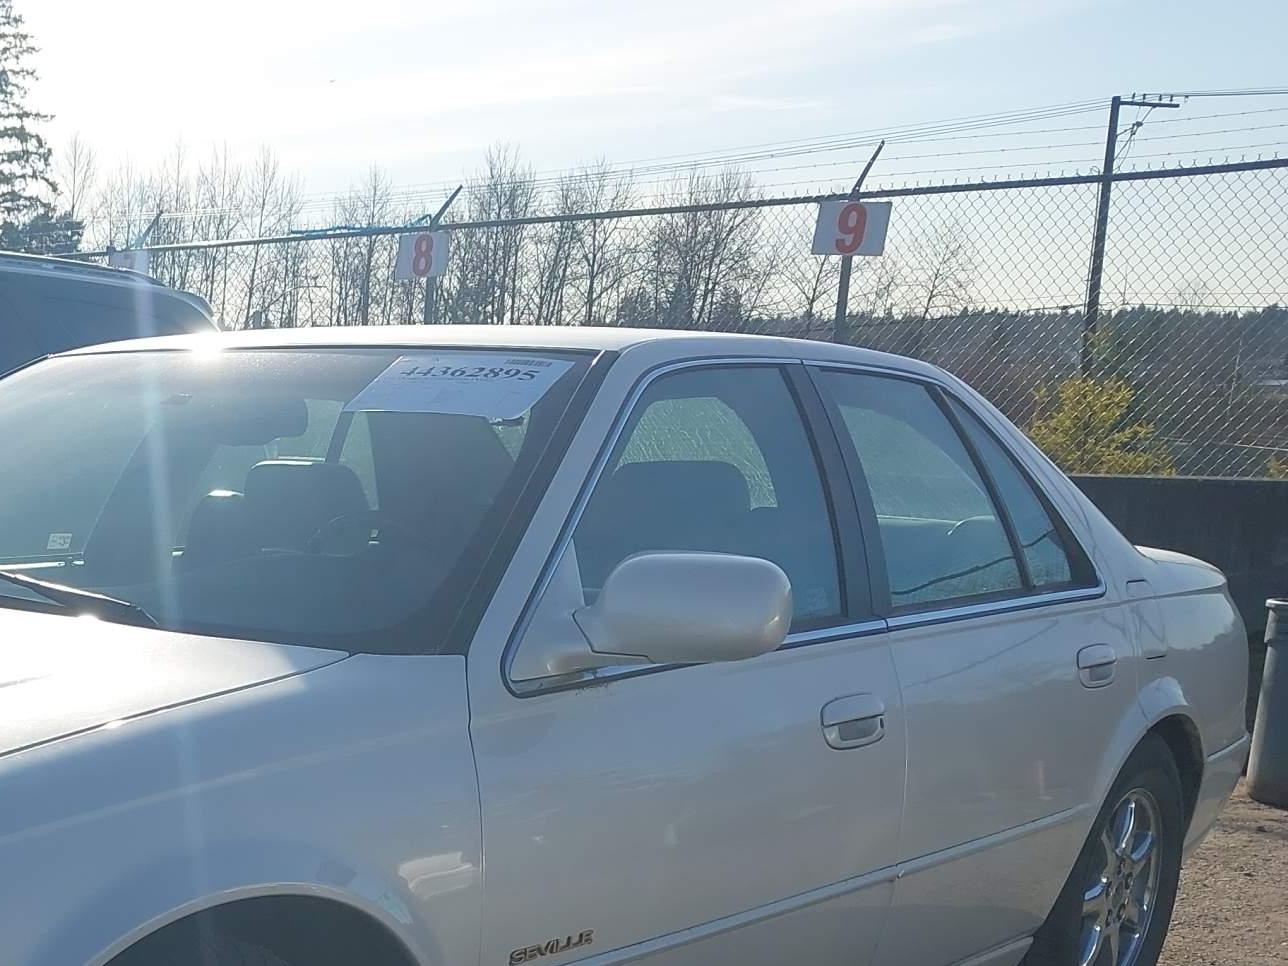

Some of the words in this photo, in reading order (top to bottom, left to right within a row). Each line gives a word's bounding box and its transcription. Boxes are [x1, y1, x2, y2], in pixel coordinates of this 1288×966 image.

[835, 203, 867, 254] 9
[412, 234, 434, 276] 8
[399, 366, 541, 381] 44362895
[508, 927, 594, 966] SEVILLE
